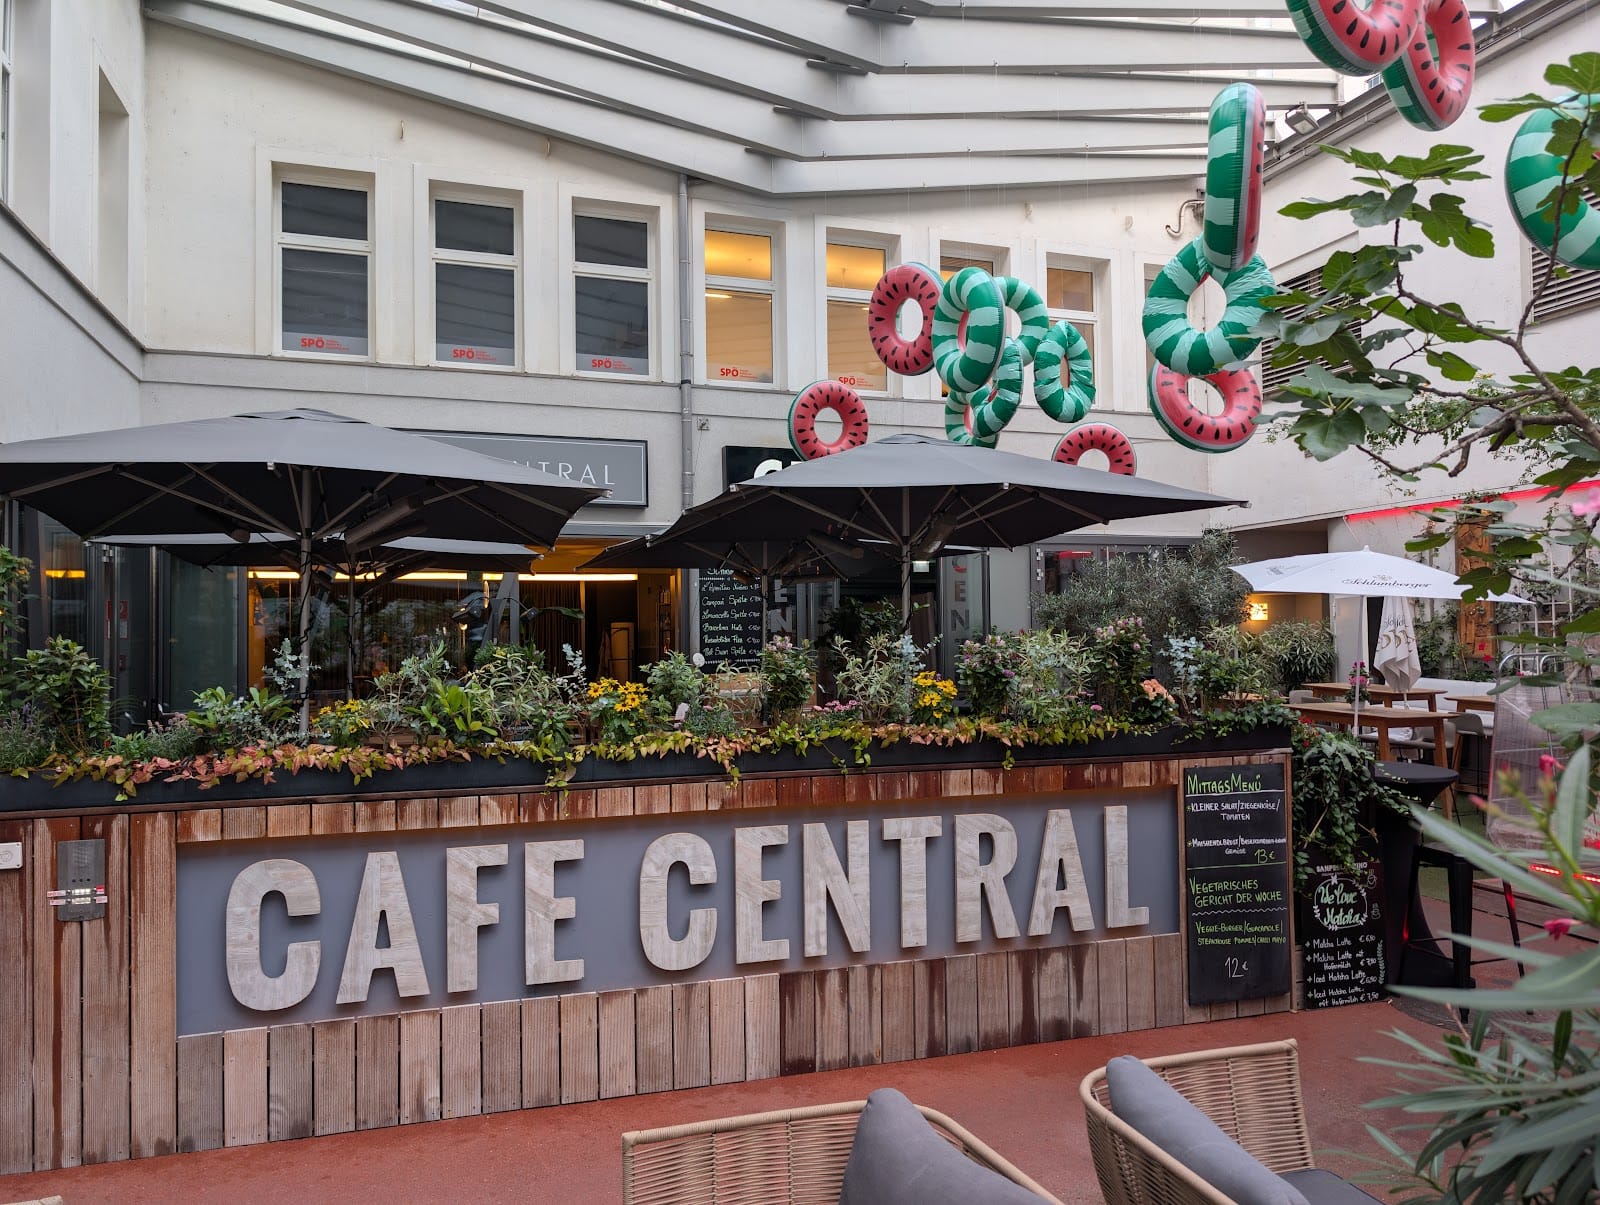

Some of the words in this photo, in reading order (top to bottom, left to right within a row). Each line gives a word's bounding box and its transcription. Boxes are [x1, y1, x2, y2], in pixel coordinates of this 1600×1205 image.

[301, 336, 325, 349] SPÖ
[452, 348, 475, 360] SPÖ
[591, 357, 612, 369] SPÖ
[720, 367, 739, 377] SPÖ
[838, 376, 856, 386] SPÖ
[1342, 577, 1432, 589] Schlumberger
[1191, 802, 1220, 812] KLEINER
[1221, 813, 1251, 821] TOMATEN
[1189, 876, 1259, 895] VEGETARISCHES
[1194, 894, 1233, 908] GERICHT
[1236, 893, 1252, 904] DER
[1255, 890, 1282, 903] WOCHE
[226, 838, 585, 1011] CAFE
[639, 805, 1150, 971] CENTRAL
[1313, 938, 1334, 949] Matcha
[1337, 937, 1352, 947] Latte
[1313, 952, 1335, 963] Matcha
[1337, 950, 1352, 960] Latte
[1313, 972, 1326, 983] Iced
[1328, 972, 1350, 981] Matcha
[1351, 970, 1366, 980] Latte
[1313, 989, 1326, 999] Iced
[1328, 988, 1347, 996] Matcha
[1318, 998, 1328, 1007] mit
